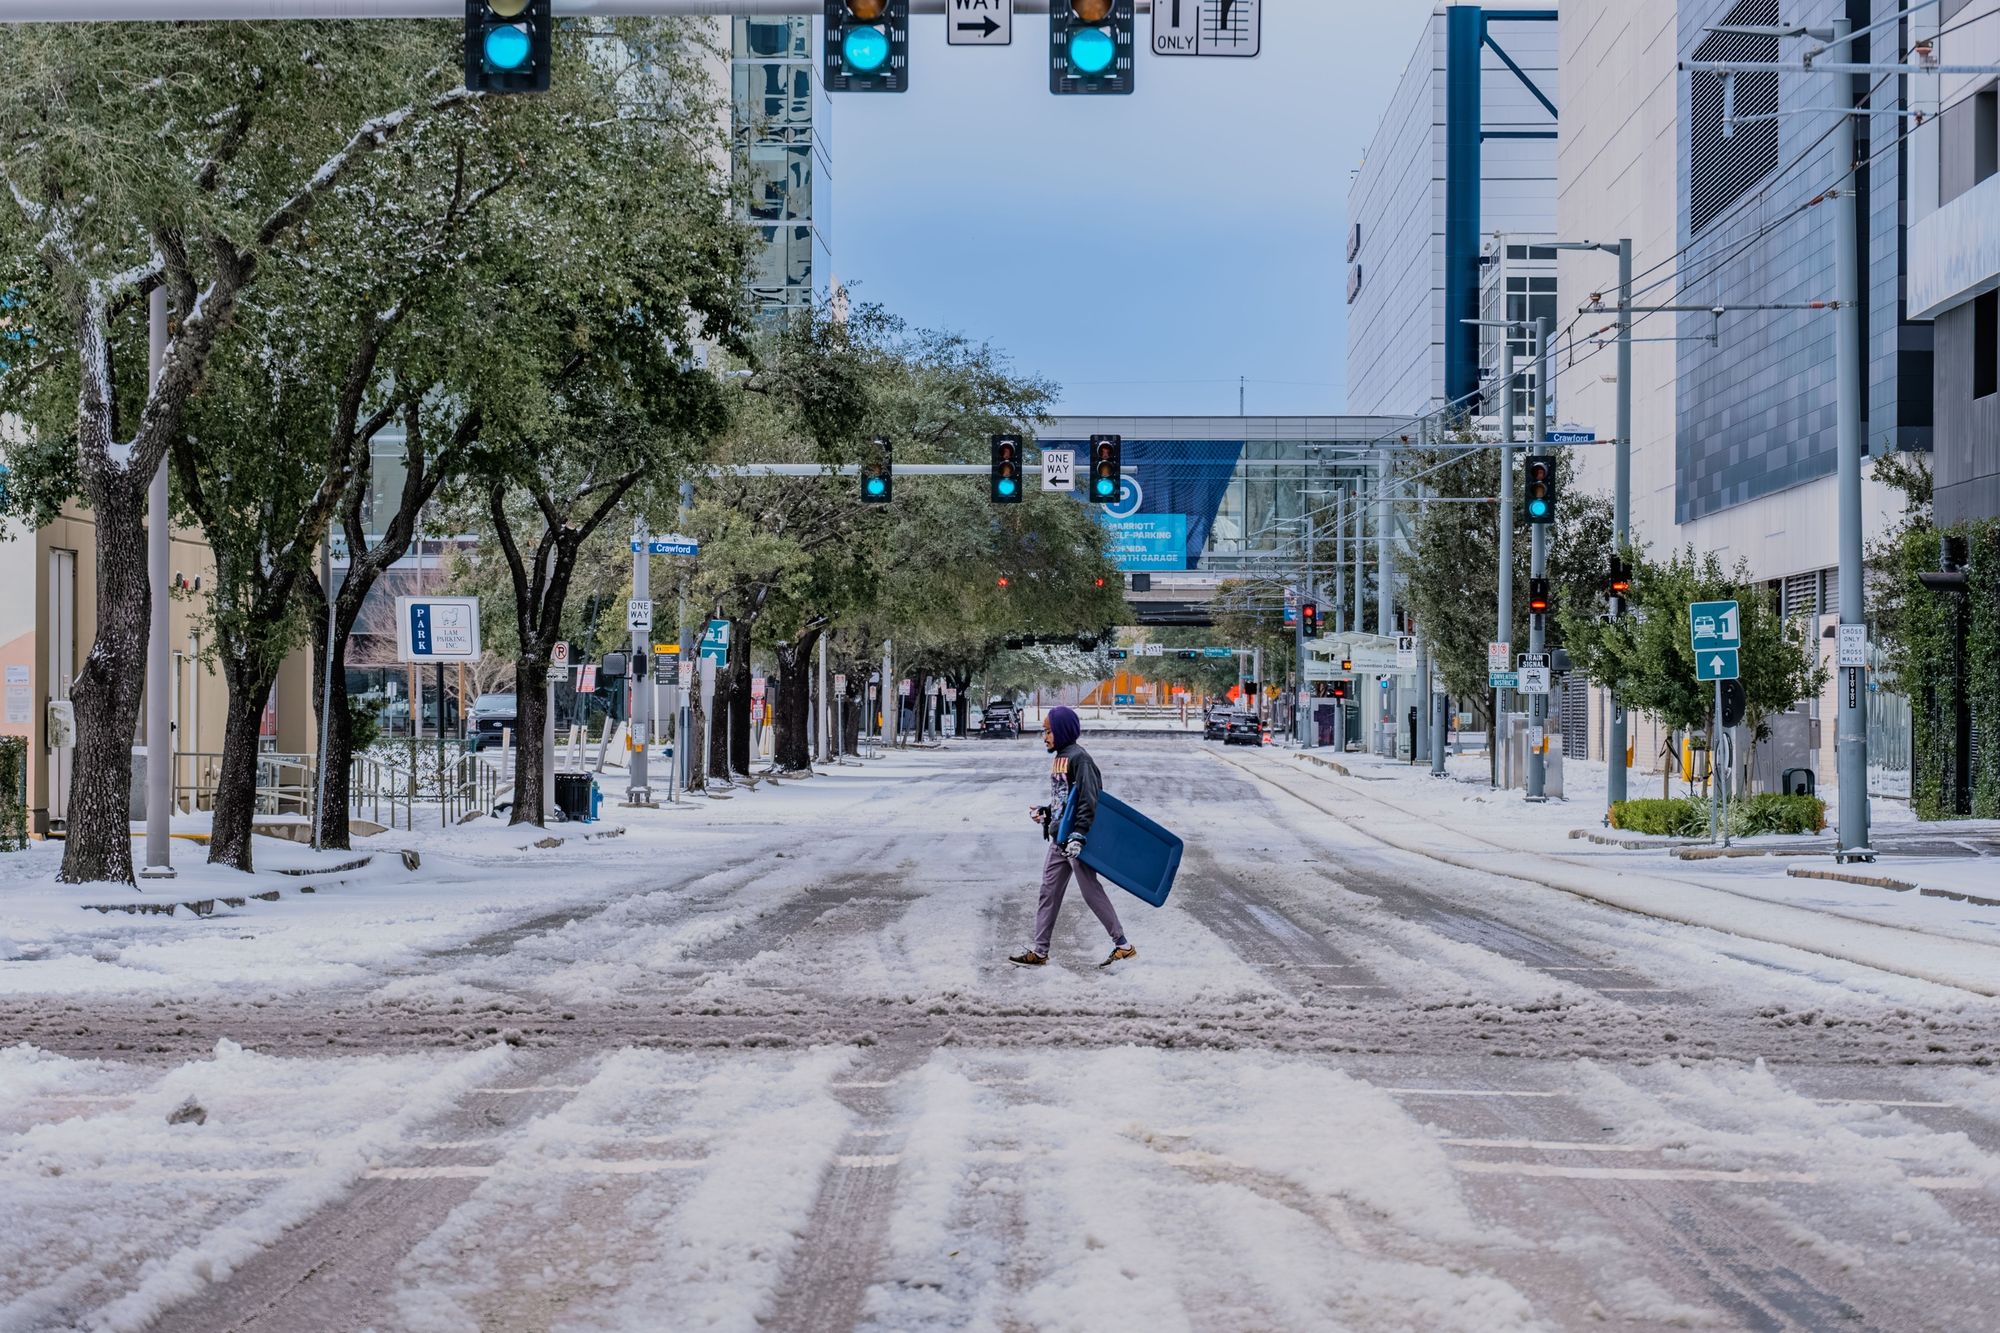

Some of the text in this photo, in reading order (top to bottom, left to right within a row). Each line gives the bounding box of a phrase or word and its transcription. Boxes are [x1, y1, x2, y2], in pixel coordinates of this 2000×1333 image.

[1157, 35, 1194, 49] ONLY
[1553, 433, 1588, 442] Crawford
[1048, 454, 1069, 463] ONE
[1047, 465, 1069, 474] WAY
[656, 544, 691, 554] Crawford
[1141, 554, 1178, 562] GARAGE
[631, 602, 649, 610] ONE
[416, 608, 426, 650] PARK
